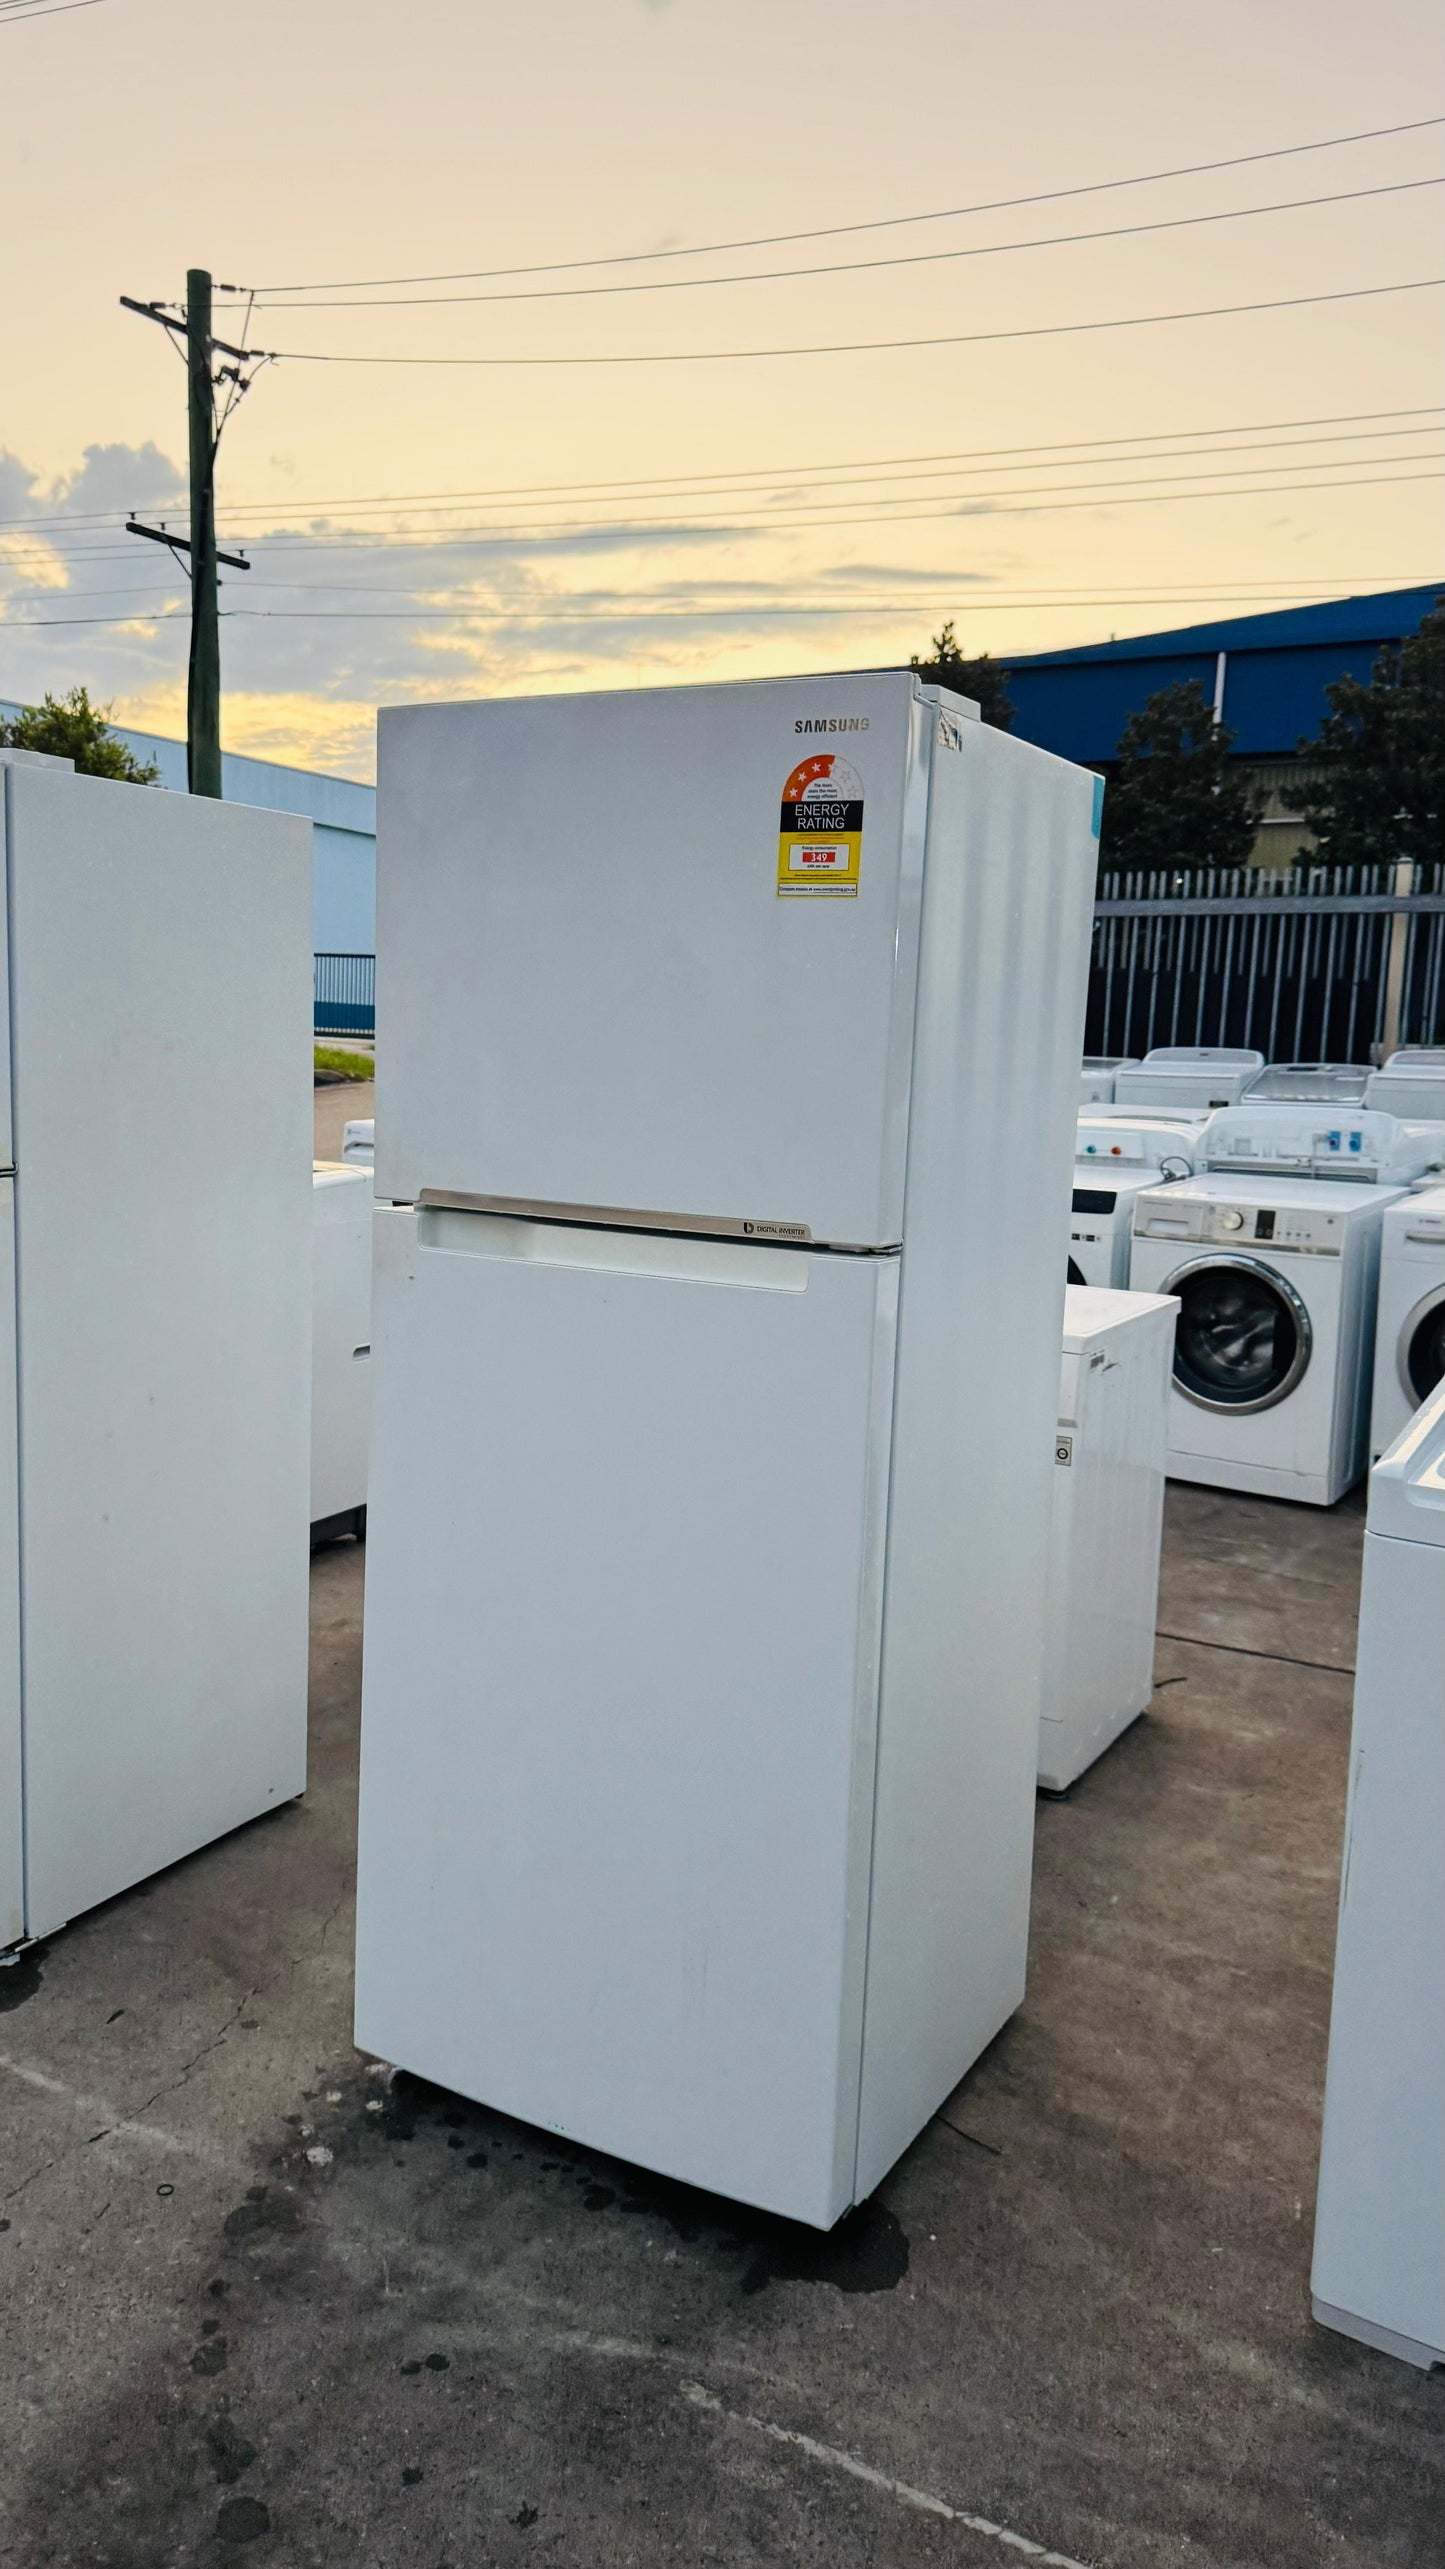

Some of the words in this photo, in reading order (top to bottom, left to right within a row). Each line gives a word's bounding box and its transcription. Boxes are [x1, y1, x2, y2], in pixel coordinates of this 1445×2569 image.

[794, 718, 870, 734] SAMSUNG
[795, 803, 849, 816] ENERGY
[797, 817, 845, 830] RATING
[811, 853, 827, 862] 349
[757, 1225, 777, 1233] DIGITAL
[779, 1227, 805, 1235] INVERTER
